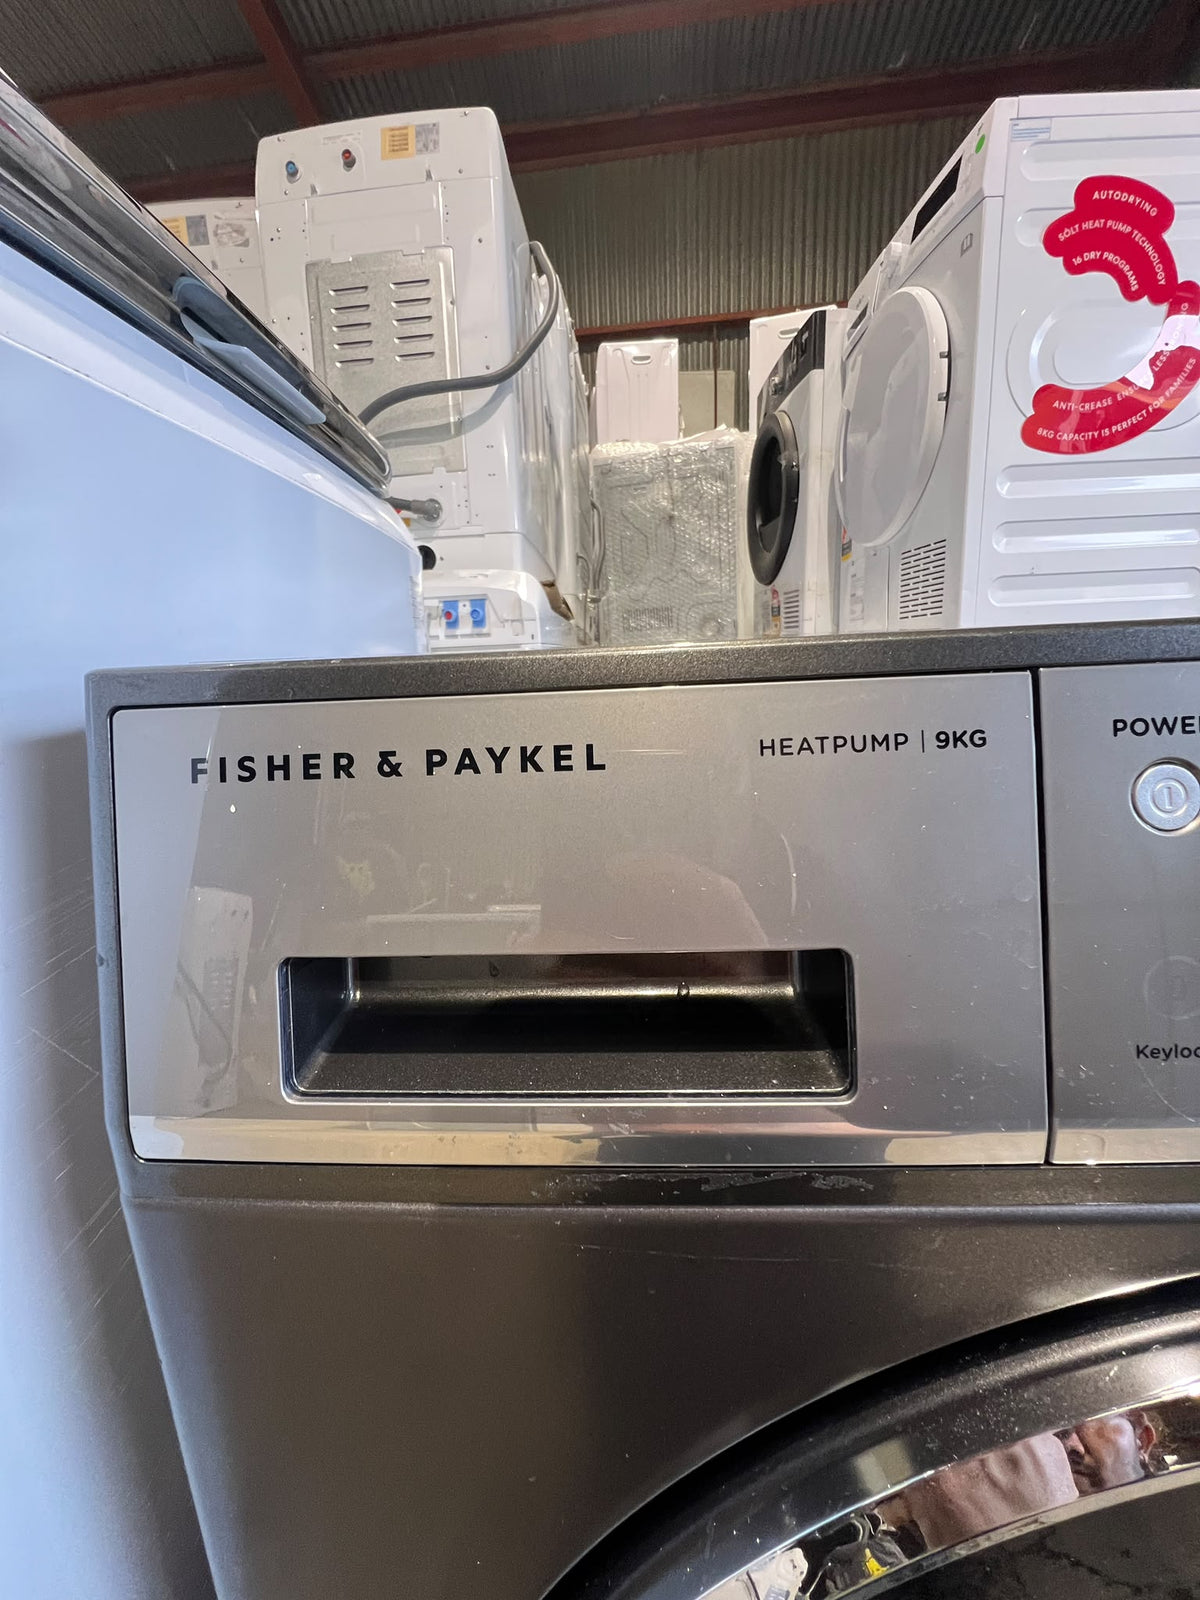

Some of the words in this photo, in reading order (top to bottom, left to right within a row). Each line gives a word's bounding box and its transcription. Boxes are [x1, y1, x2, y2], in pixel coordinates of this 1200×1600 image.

[1092, 190, 1158, 217] AUTODRYING
[1071, 255, 1083, 266] 16
[1083, 251, 1101, 262] DRY
[1102, 251, 1140, 291] PROGRAMS
[1081, 219, 1105, 231] HEAT
[1106, 219, 1132, 234] PUMP
[1131, 229, 1166, 286] TECHNOLOGY
[1036, 427, 1054, 439] 8KG
[1056, 429, 1100, 441] CAPACITY
[1101, 428, 1110, 438] IS
[1111, 409, 1148, 434] PERFECT
[1148, 398, 1165, 413] FOR
[1165, 357, 1197, 398] FAMILIES
[1052, 396, 1113, 412] ANTI-CREASE
[1152, 349, 1170, 372] LESS
[759, 732, 909, 757] HEATPUMP
[935, 729, 988, 750] 9KG
[1112, 716, 1200, 737] POWE
[190, 752, 356, 785] FISHER
[376, 750, 404, 778] &
[425, 743, 607, 776] PAYKEL
[1136, 1043, 1200, 1062] Keyloc
